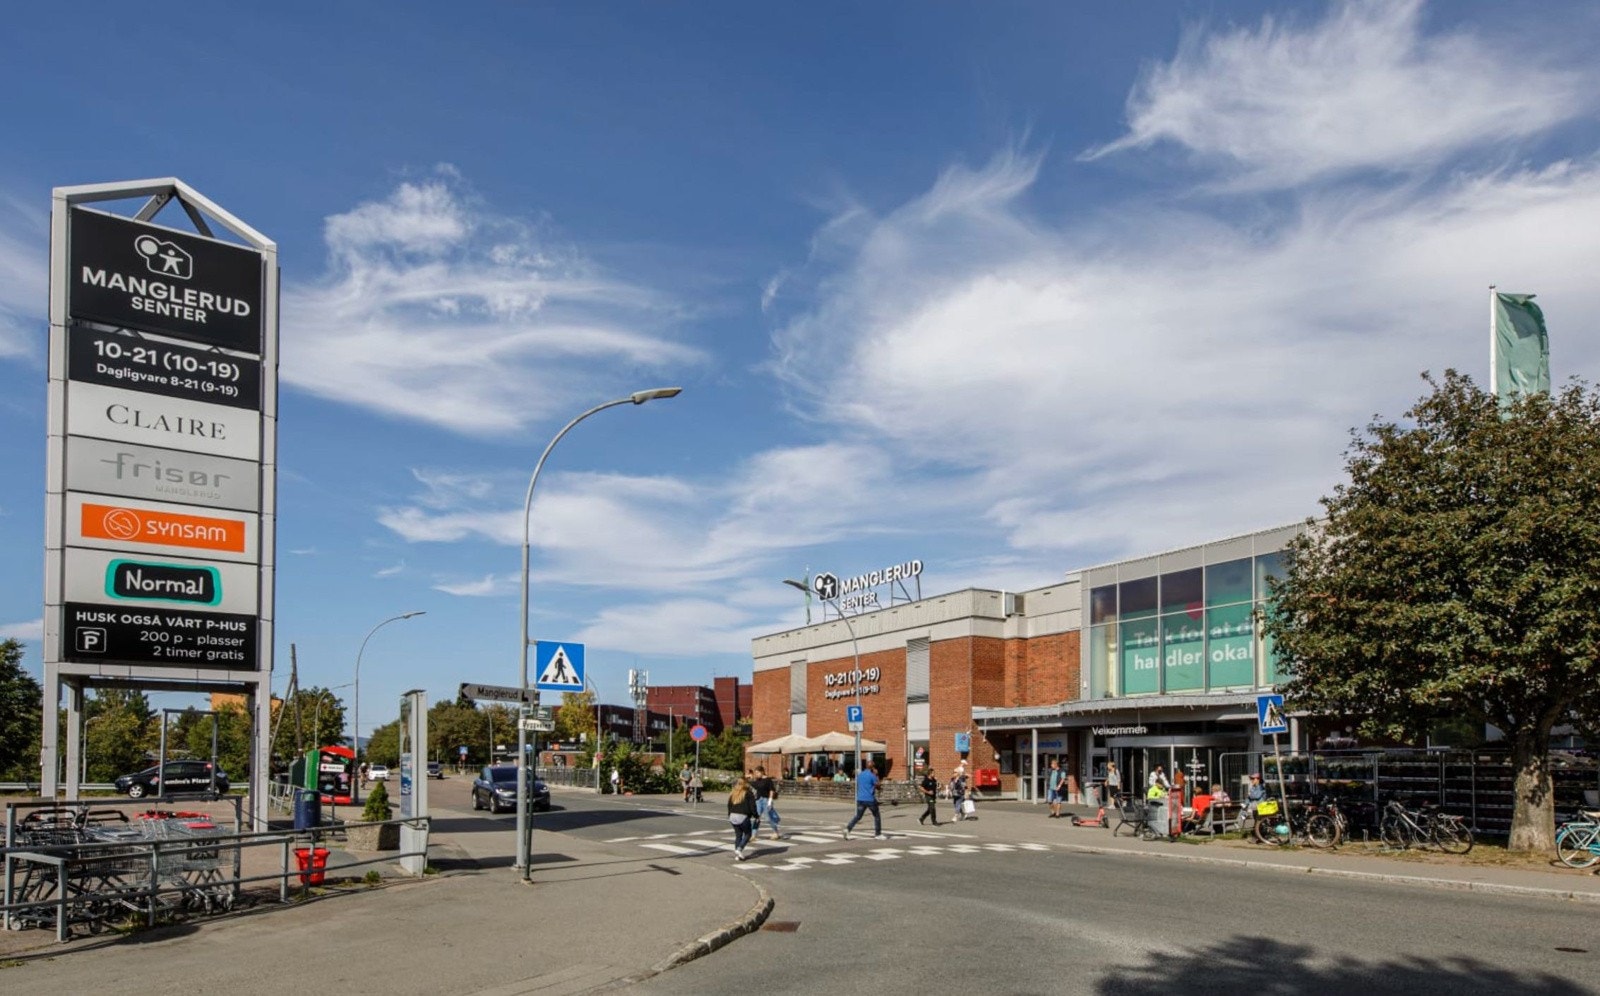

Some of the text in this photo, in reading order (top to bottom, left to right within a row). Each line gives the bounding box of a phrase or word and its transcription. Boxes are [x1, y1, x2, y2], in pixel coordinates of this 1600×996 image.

[82, 266, 250, 316] MANGLERUD
[131, 296, 207, 323] SENTER
[93, 340, 240, 382] 10-21 (10-19)
[96, 363, 239, 398] Dagligvare 8-21 (9-19)
[106, 403, 226, 441] CLAIRE
[100, 452, 231, 488] frisør
[155, 485, 221, 500] MANGLERUD
[146, 520, 227, 542] SYNSAM
[125, 569, 204, 595] Normal
[840, 560, 923, 595] MANGLERUD
[841, 592, 877, 610] SENTER
[76, 611, 247, 631] HUSK OGSÅ VÅRT P-HUS
[1210, 622, 1232, 639] at
[140, 630, 170, 643] 200
[173, 633, 184, 644] p
[197, 634, 245, 647] plasser
[153, 645, 244, 661] 2 timer gratis
[1134, 648, 1202, 670] handler
[824, 667, 880, 686] 10-21 (10-19)
[477, 687, 518, 699] Manglerud
[850, 707, 860, 721] P
[1092, 725, 1148, 736] Velkommen
